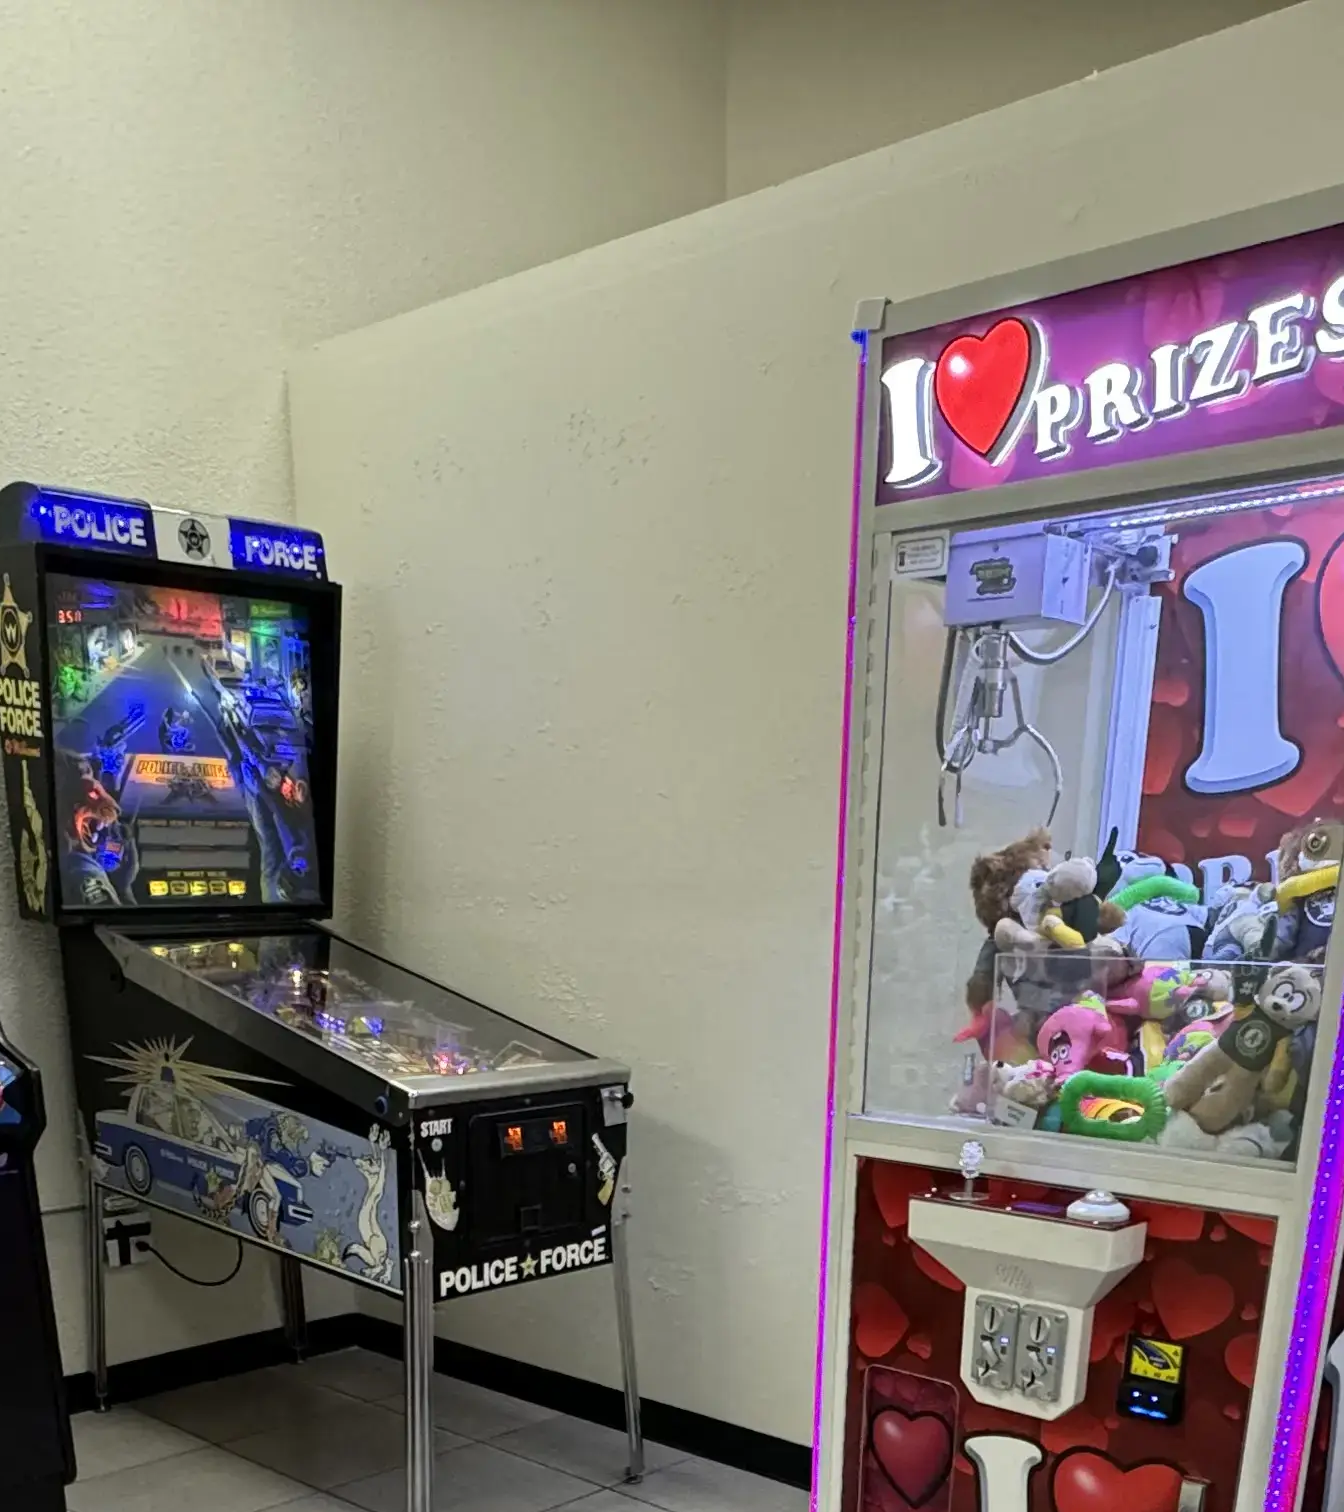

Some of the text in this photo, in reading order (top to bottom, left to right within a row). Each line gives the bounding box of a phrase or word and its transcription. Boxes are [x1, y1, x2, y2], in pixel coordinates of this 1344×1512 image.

[879, 356, 944, 489] I
[53, 505, 147, 547] POLICE
[244, 535, 318, 571] FORCE
[1181, 538, 1312, 798] I
[0, 705, 44, 738] FORCE
[420, 1118, 453, 1138] START
[440, 1236, 607, 1298] POLICE FORCE
